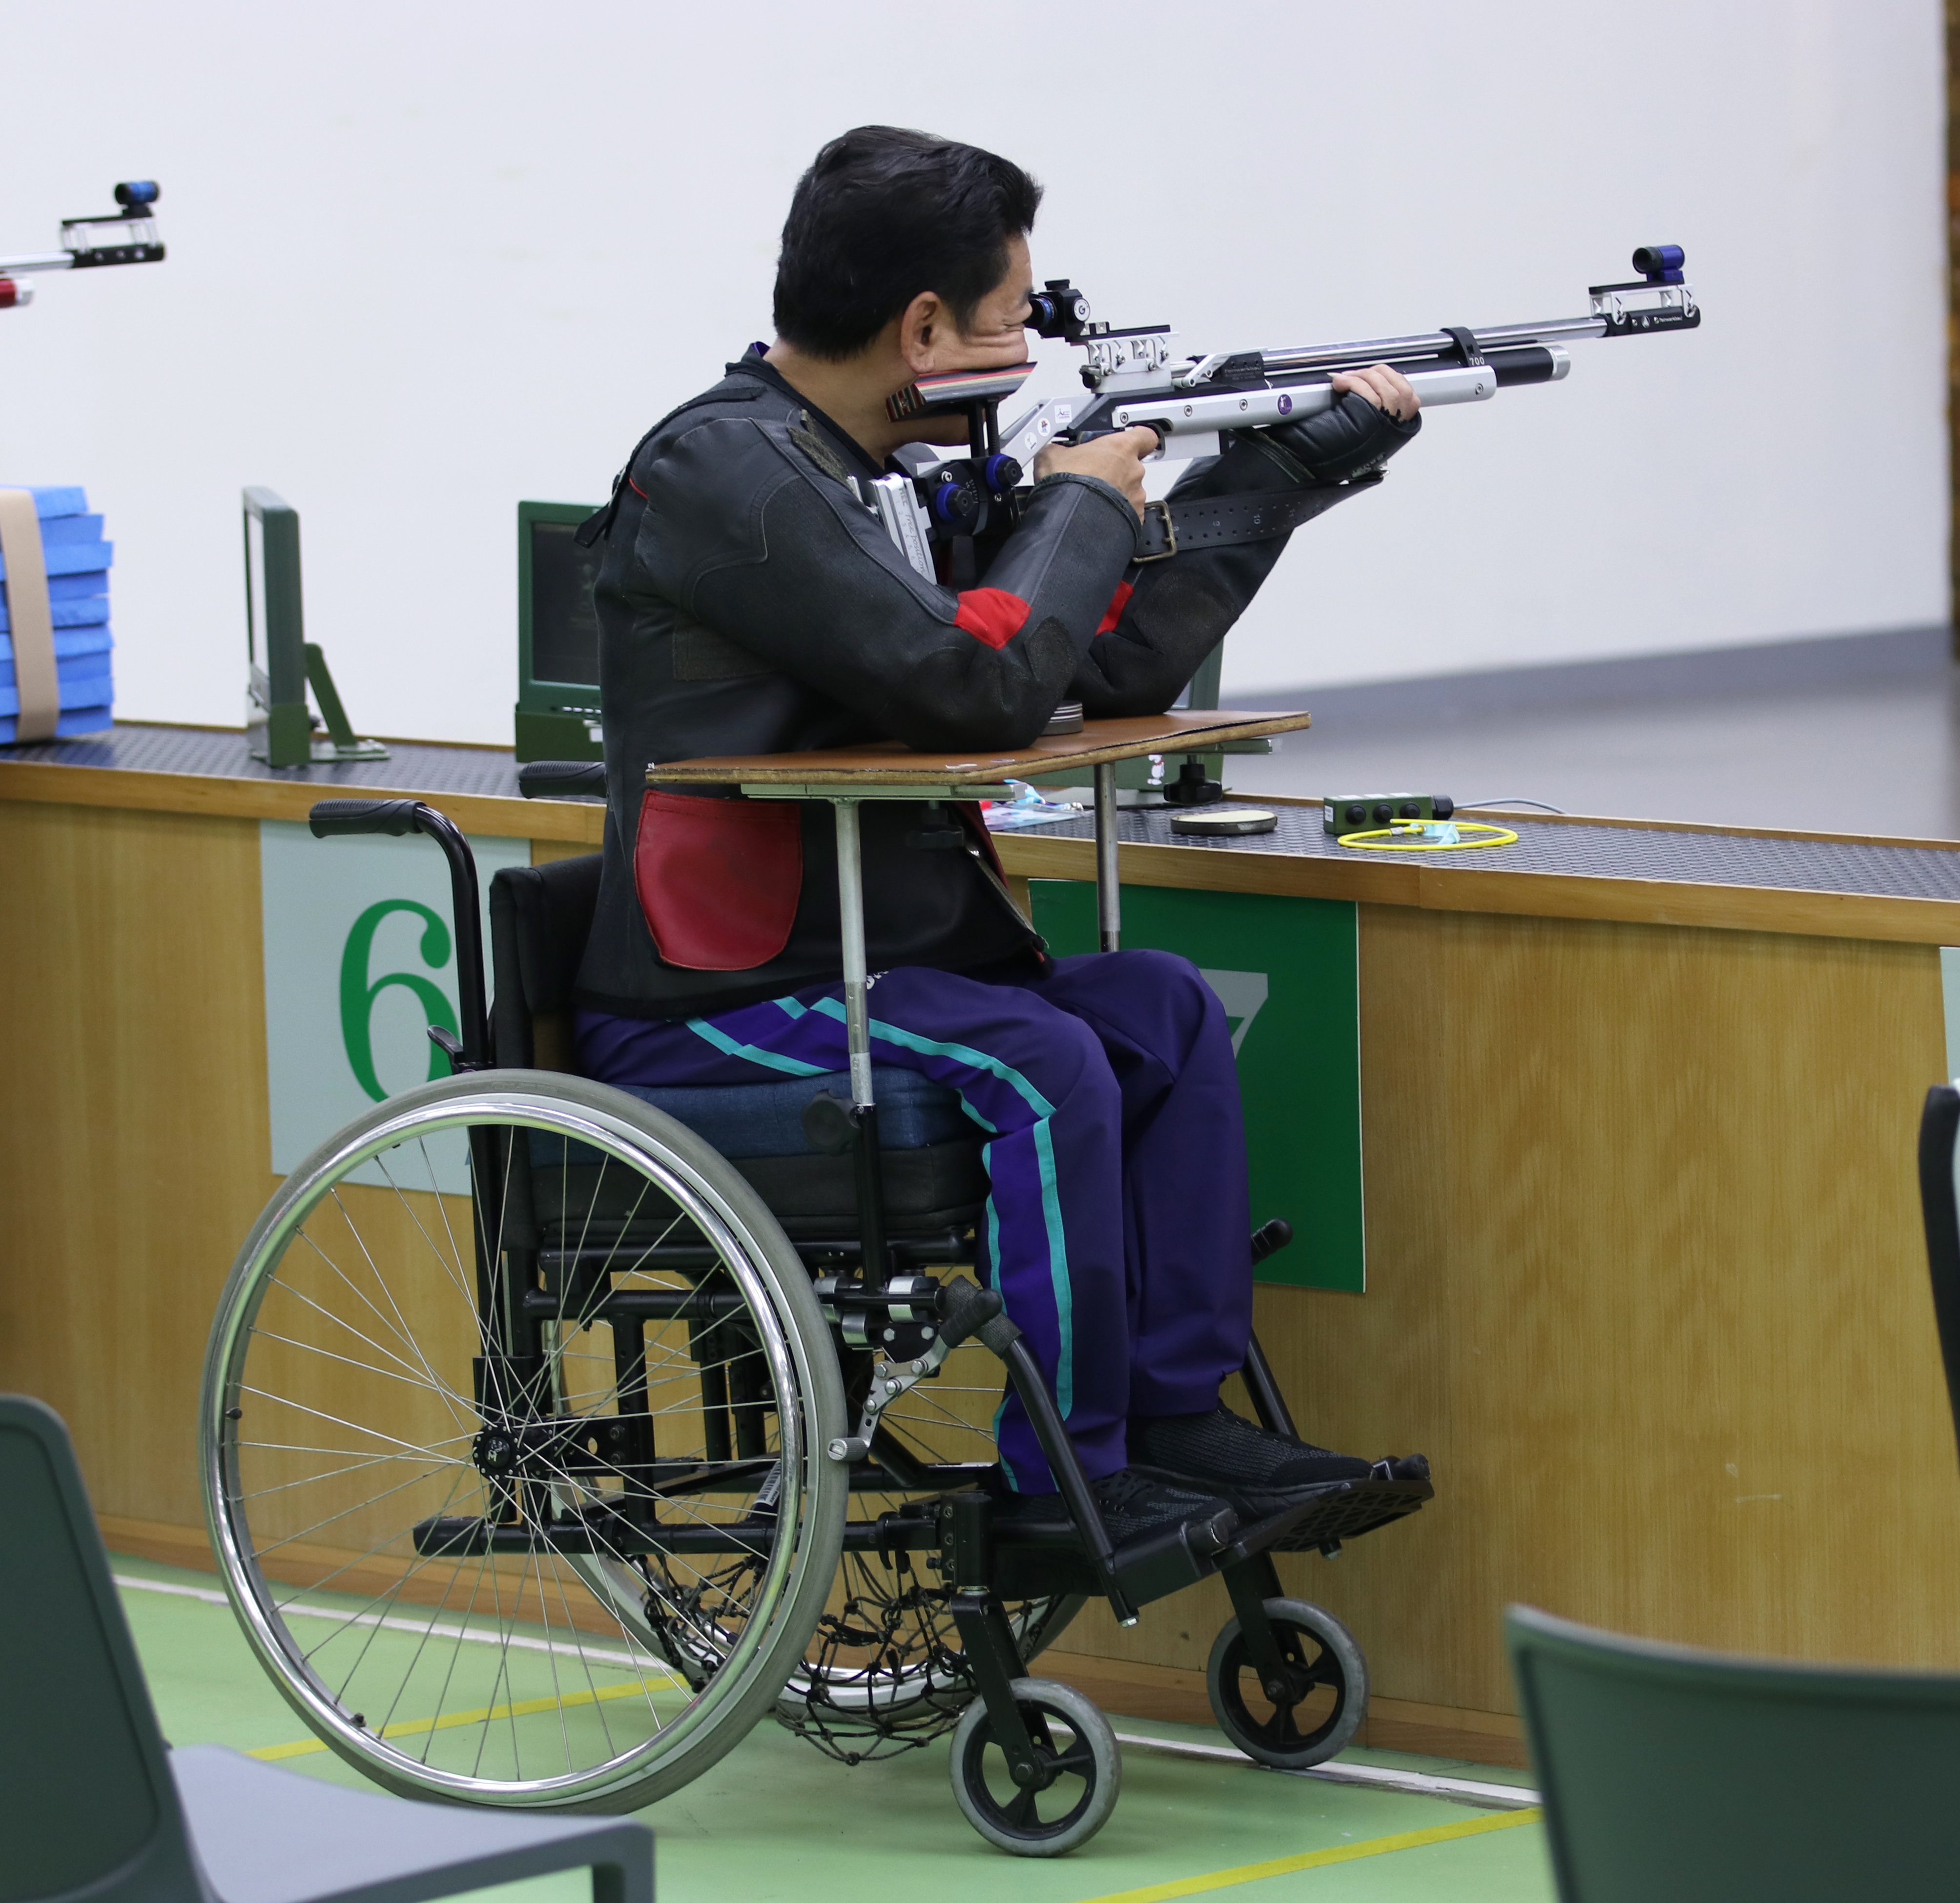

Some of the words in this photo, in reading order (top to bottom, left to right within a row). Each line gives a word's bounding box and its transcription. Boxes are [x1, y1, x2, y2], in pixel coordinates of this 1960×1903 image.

[1469, 356, 1485, 366] 700
[1254, 514, 1261, 525] 10
[910, 535, 926, 575] position
[340, 899, 459, 1103] 6
